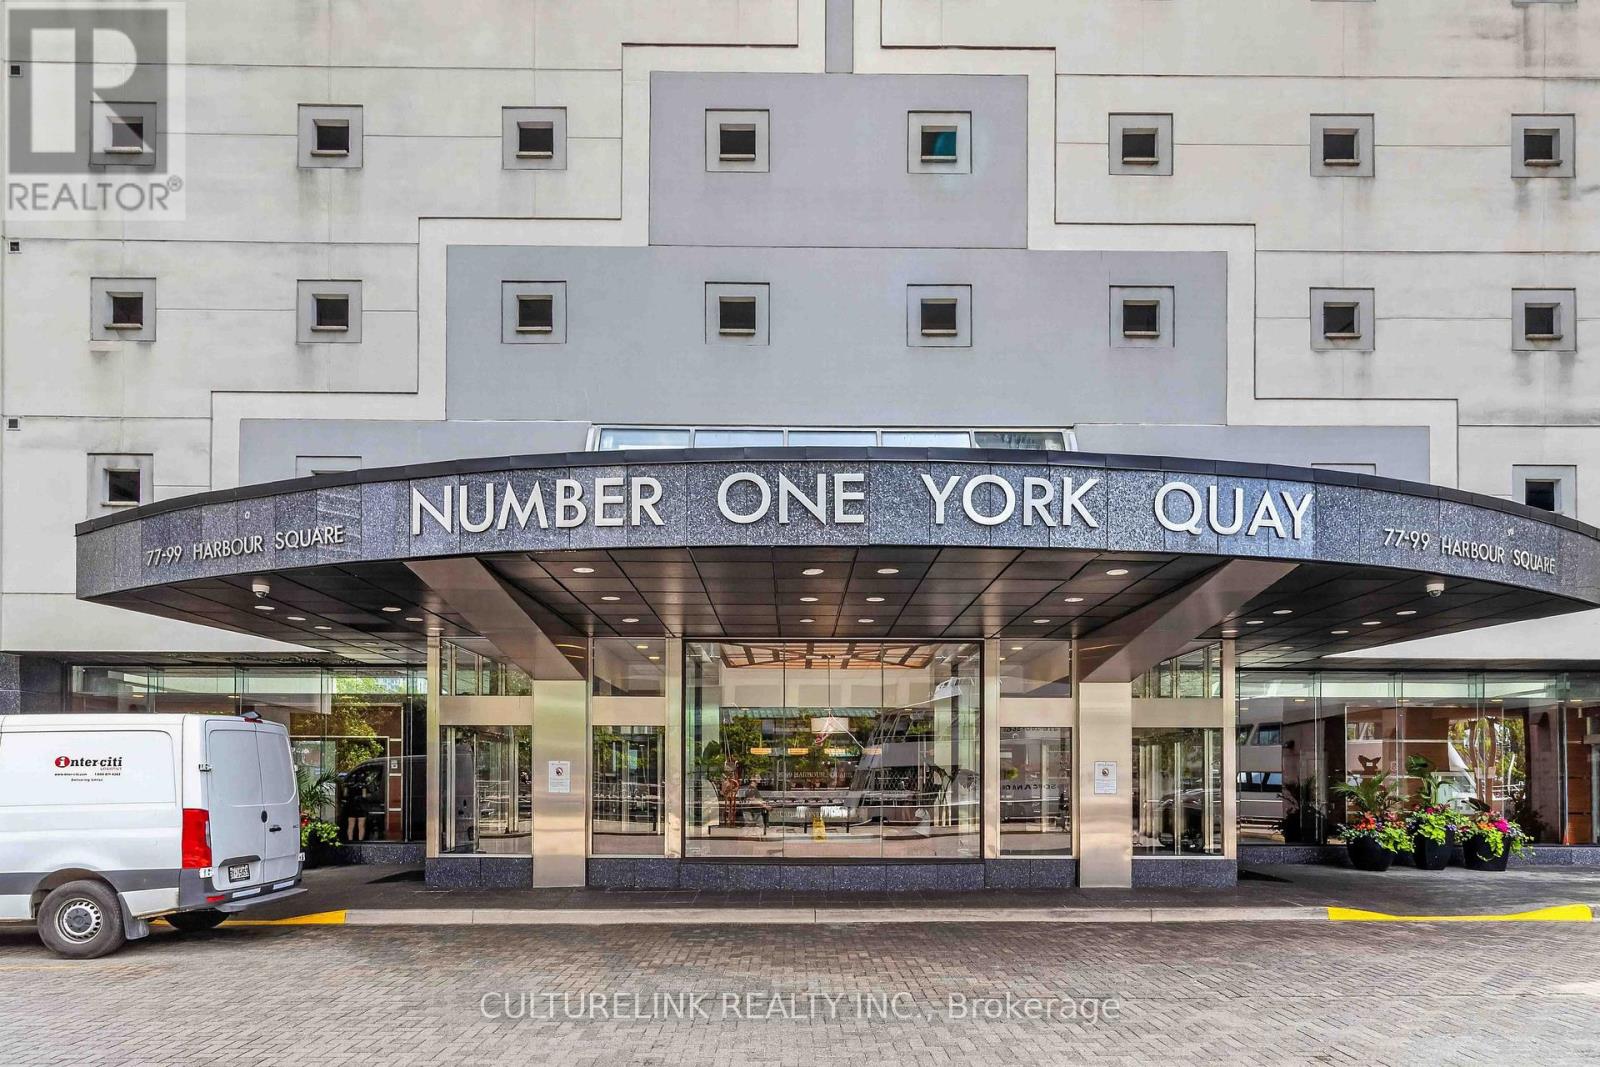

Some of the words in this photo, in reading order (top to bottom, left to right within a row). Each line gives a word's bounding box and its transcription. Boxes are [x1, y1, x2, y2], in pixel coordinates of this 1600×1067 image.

[412, 476, 665, 535] NUMBER
[717, 472, 865, 526] ONE
[921, 473, 1100, 529] YORK
[1154, 482, 1314, 539] QUAY
[147, 545, 183, 567] 77-99
[193, 535, 264, 561] HARBOUR
[275, 525, 345, 550] SQUARE
[1384, 528, 1431, 551] 77-99
[1441, 536, 1506, 563] HARBOUR
[1512, 549, 1557, 575] SQUARE
